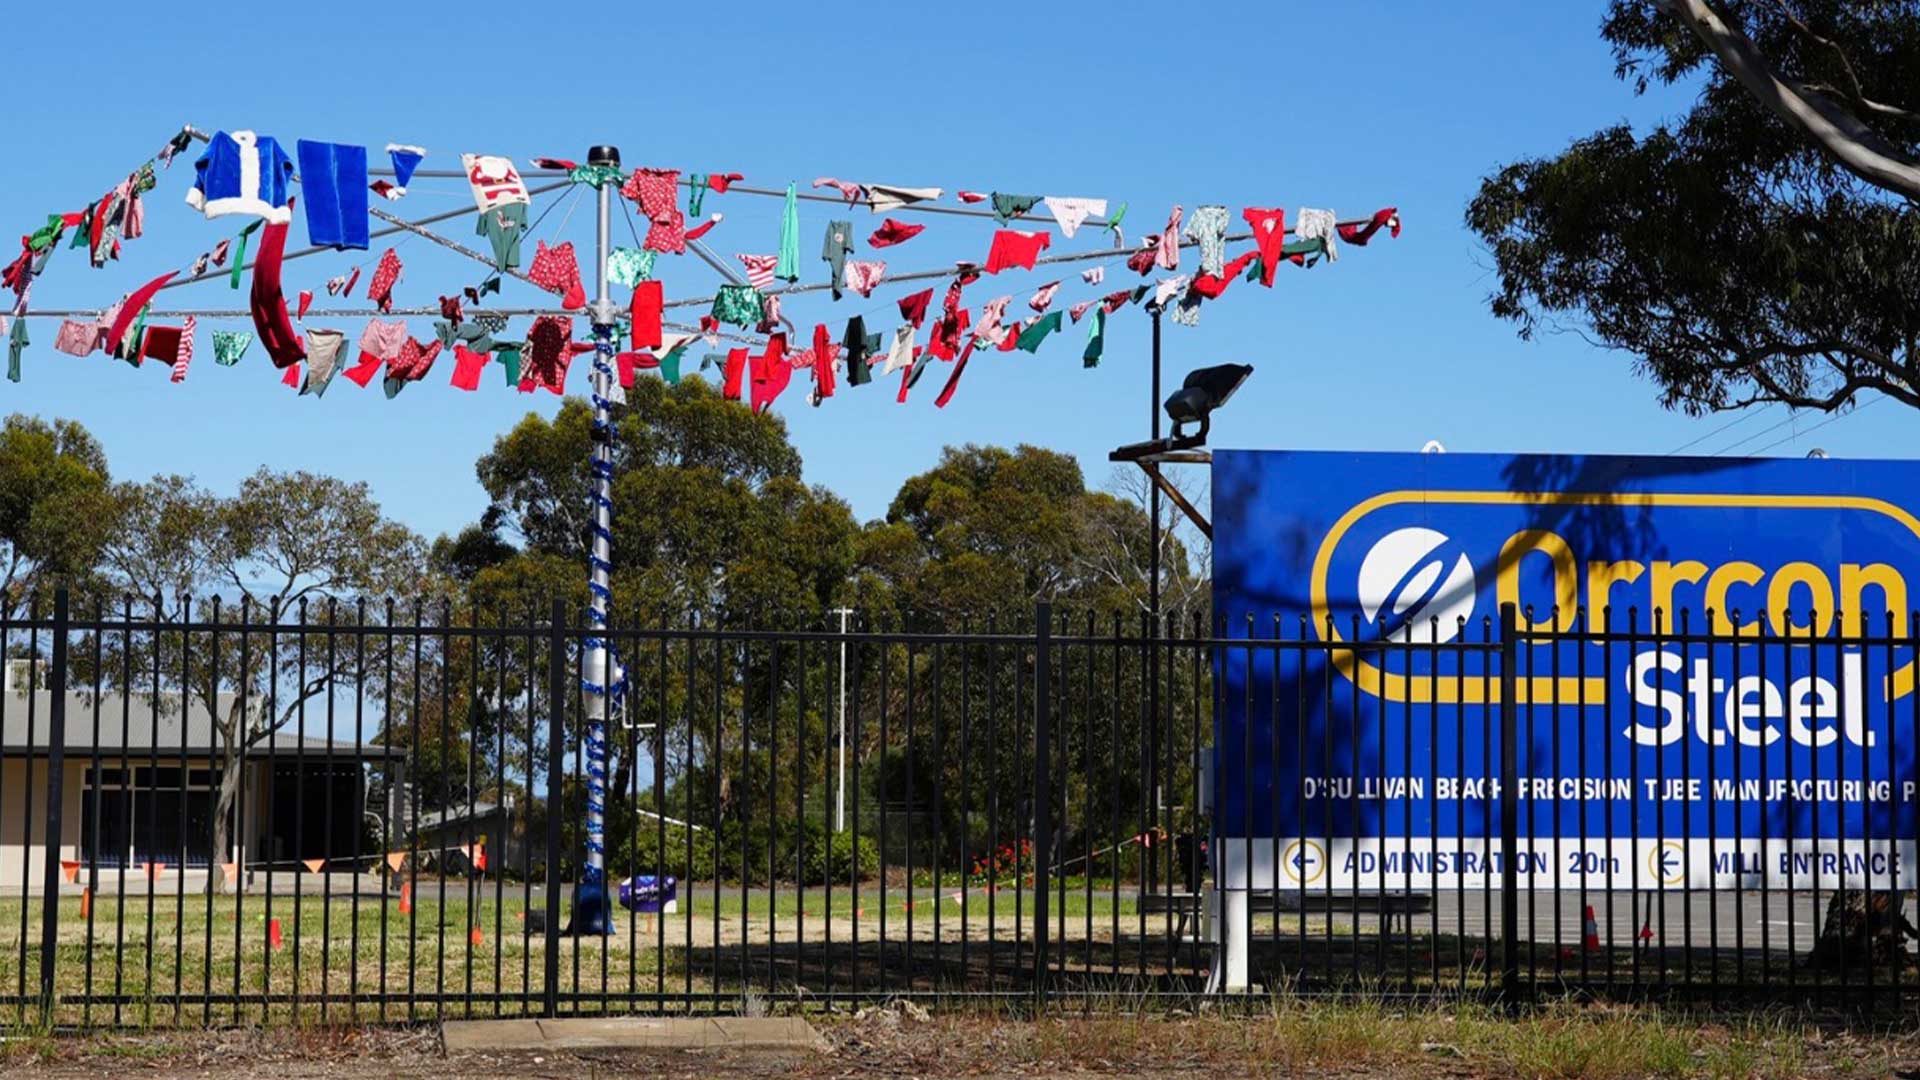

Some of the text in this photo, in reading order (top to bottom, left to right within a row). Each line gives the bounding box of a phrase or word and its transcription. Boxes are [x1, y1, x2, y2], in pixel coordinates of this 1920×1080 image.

[1495, 528, 1908, 647] Orrcon
[1622, 650, 1875, 747] Steel
[1303, 776, 1424, 800] O'SULIVAN
[1343, 851, 1620, 875] ADMINISTRATON 20m
